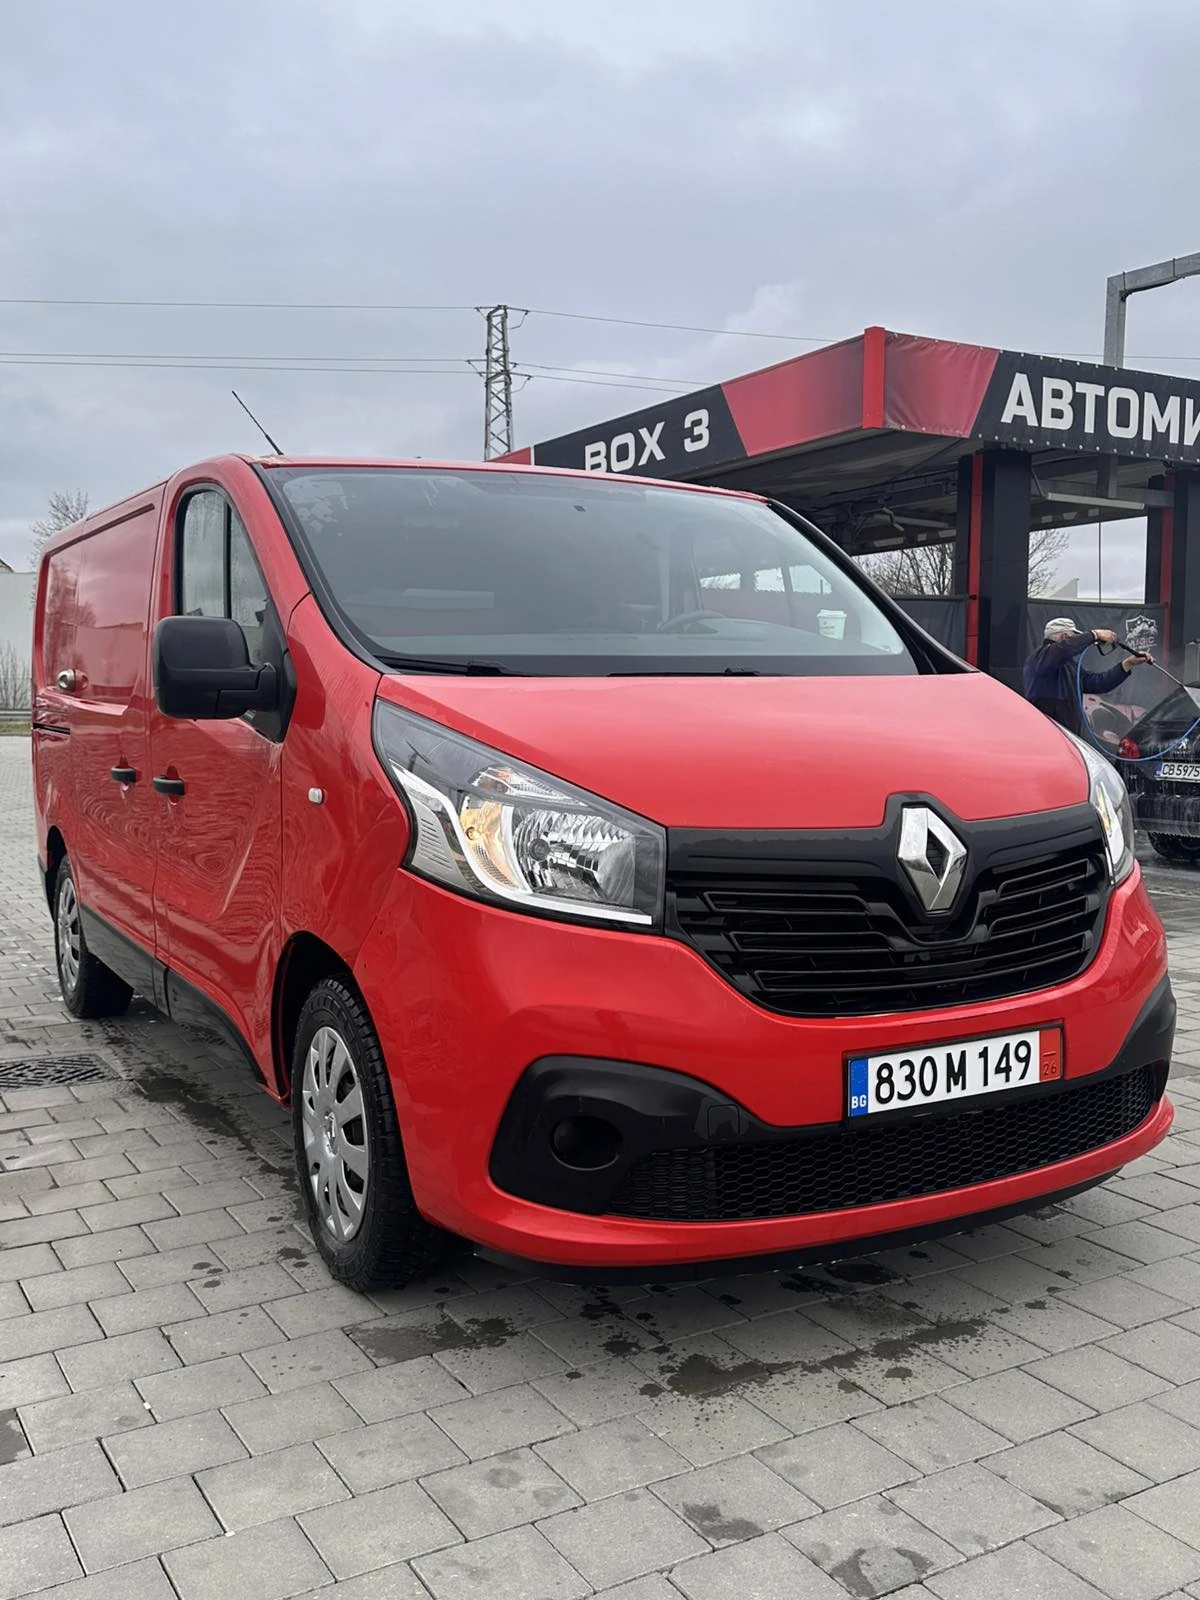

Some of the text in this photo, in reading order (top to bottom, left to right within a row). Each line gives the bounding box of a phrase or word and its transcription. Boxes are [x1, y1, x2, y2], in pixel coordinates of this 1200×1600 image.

[584, 408, 710, 473] BOX 3
[1162, 764, 1175, 776] CB
[875, 1040, 1032, 1105] 830 M 149
[1043, 1062, 1057, 1076] 26
[851, 1094, 867, 1109] BG
